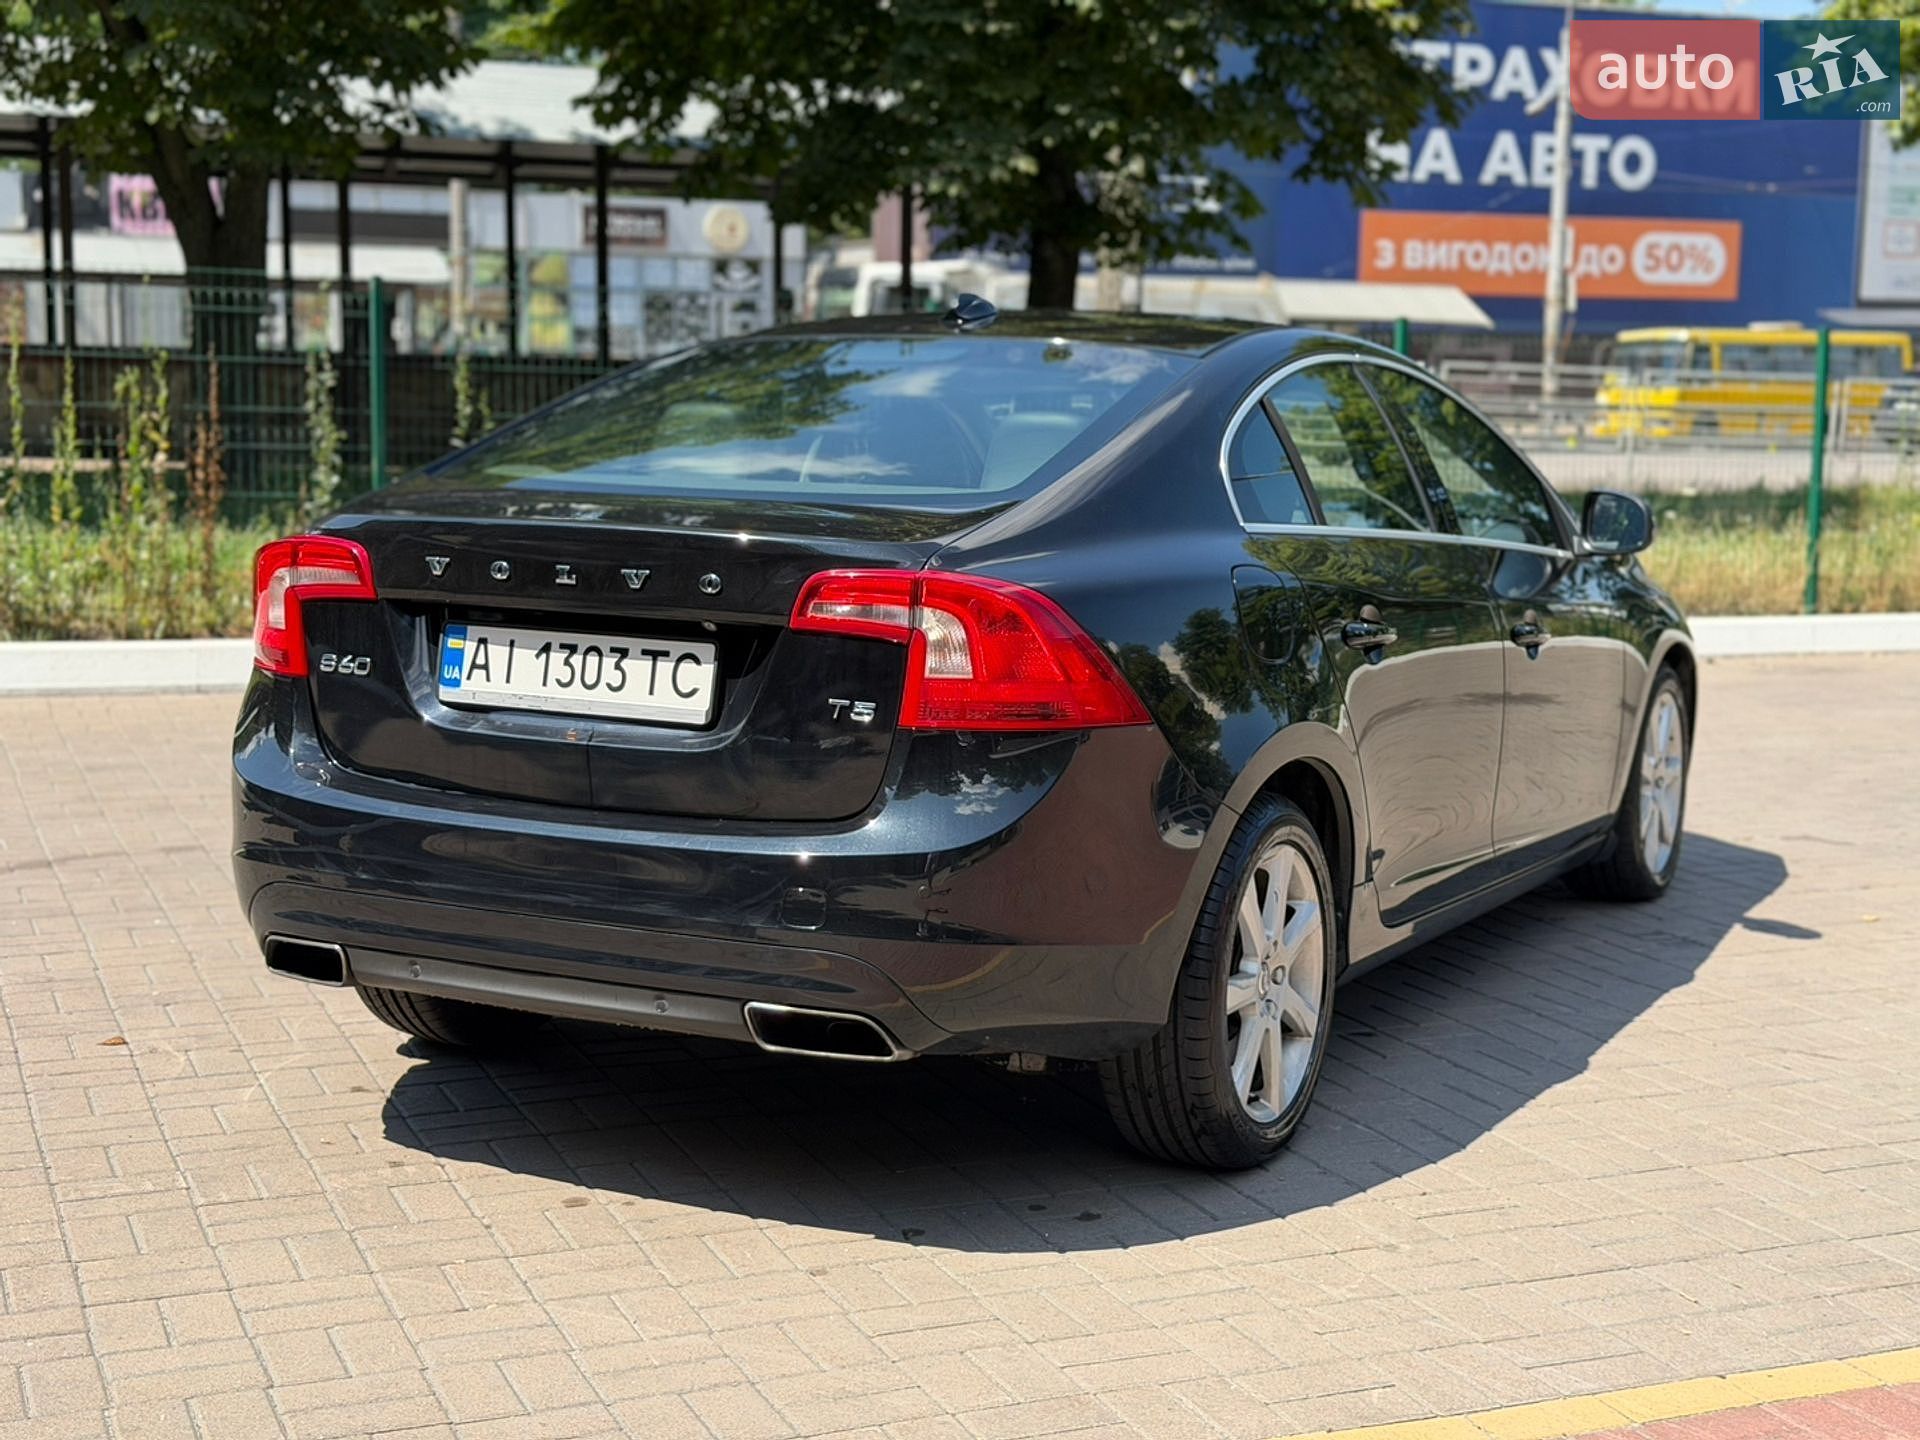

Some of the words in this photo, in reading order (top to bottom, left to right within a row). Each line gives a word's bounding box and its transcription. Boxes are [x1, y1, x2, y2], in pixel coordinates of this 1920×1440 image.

[1478, 130, 1657, 191] АВТО
[1642, 240, 1716, 277] 50%
[425, 556, 722, 594] VOLVO
[319, 653, 371, 675] S60
[444, 664, 460, 679] UA
[534, 641, 630, 693] 1303
[641, 648, 701, 699] TC
[828, 698, 876, 722] T5
